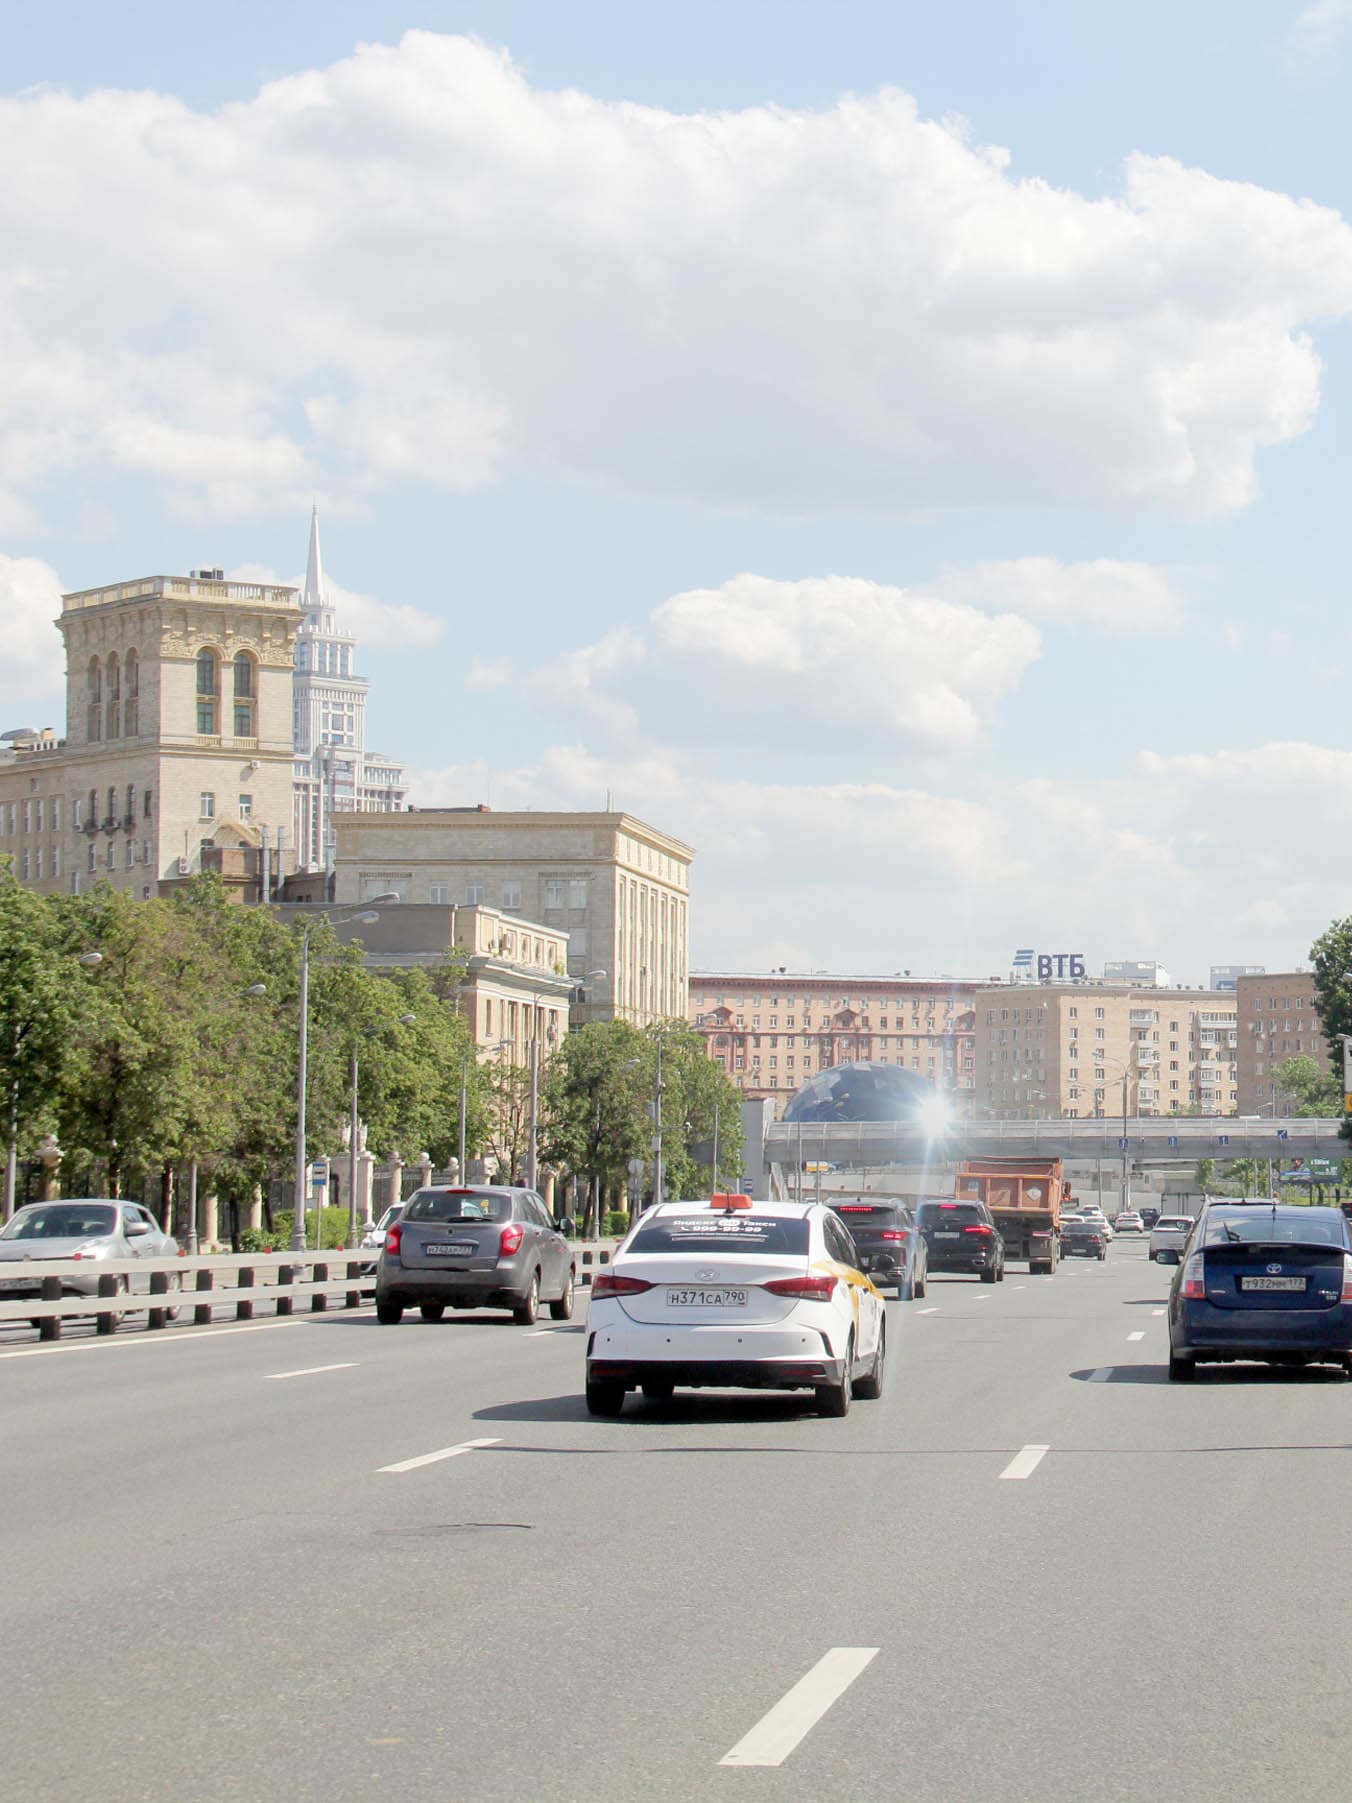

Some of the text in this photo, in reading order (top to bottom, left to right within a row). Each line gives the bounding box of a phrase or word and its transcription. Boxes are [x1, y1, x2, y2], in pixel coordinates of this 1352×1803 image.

[1038, 954, 1085, 979] ВТБ
[671, 1291, 745, 1305] Н371СА 790
